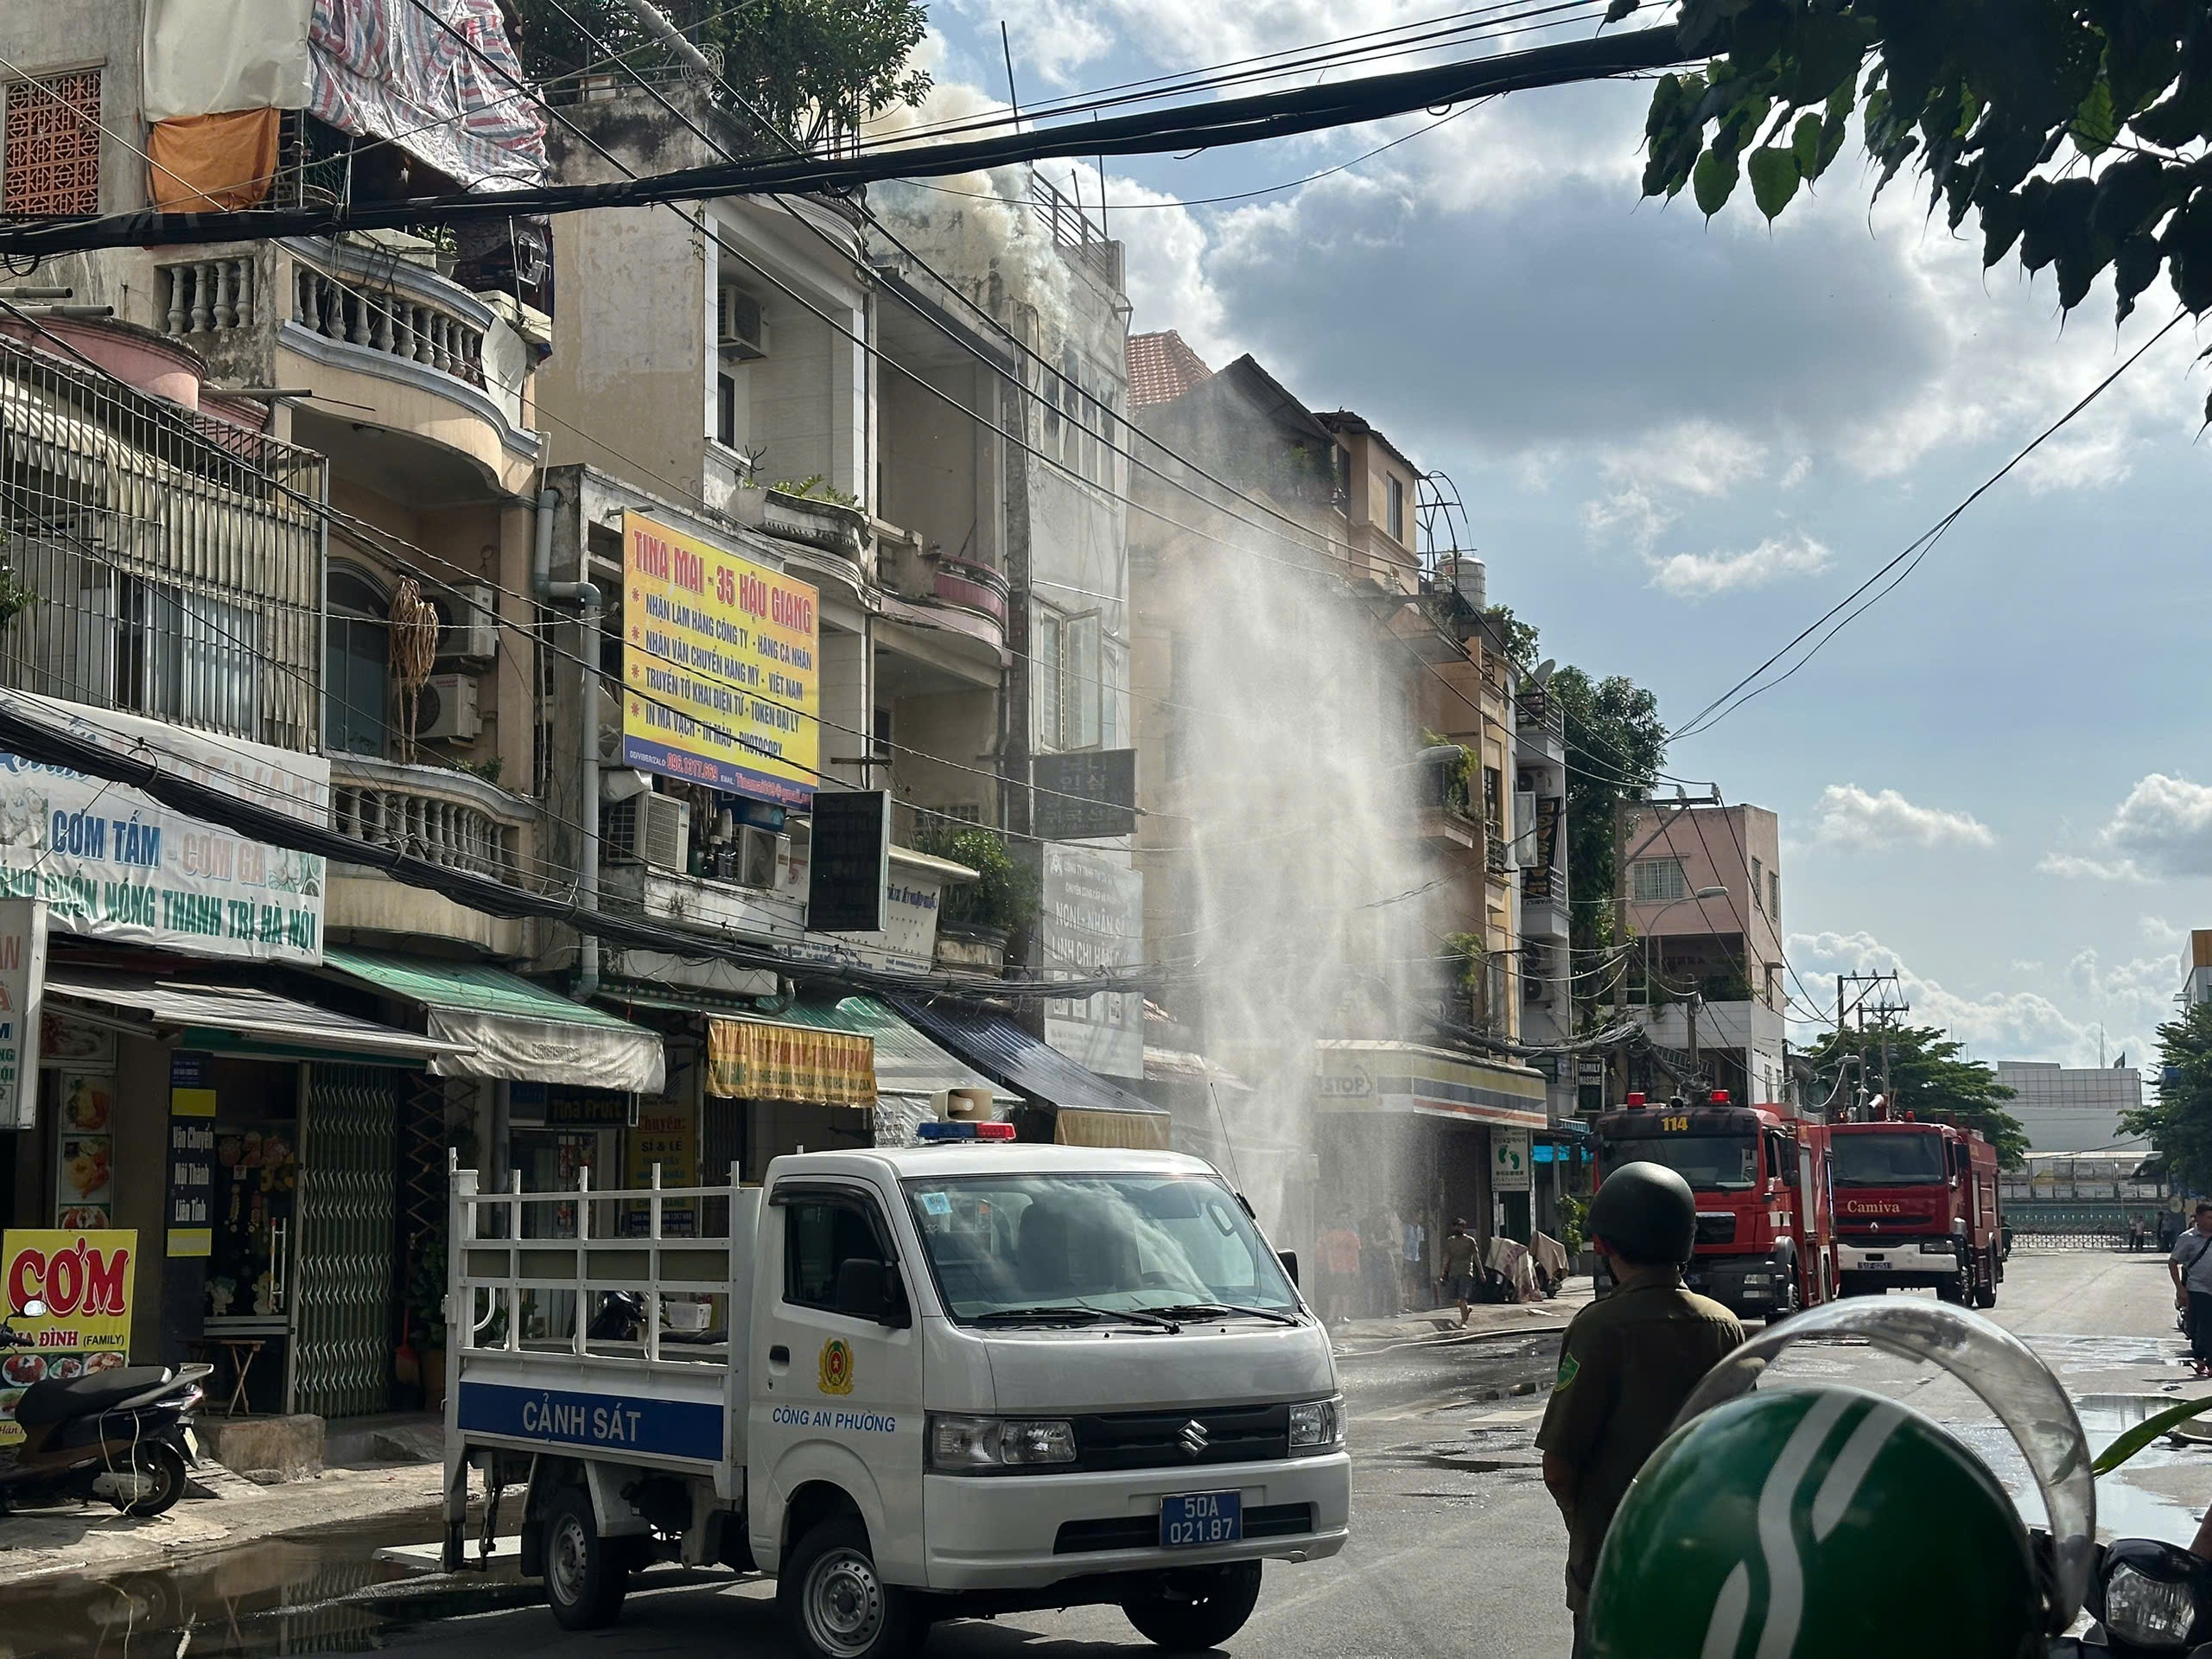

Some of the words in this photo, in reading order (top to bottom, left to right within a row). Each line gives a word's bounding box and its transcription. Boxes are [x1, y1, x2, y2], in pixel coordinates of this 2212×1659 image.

[632, 530, 670, 582] TINA
[674, 547, 704, 596] MAI
[715, 564, 735, 606] 35
[738, 570, 767, 623] HẬU
[770, 588, 812, 635] GIANG
[645, 592, 670, 624] NHẬN
[671, 599, 690, 628] LÀM
[691, 607, 714, 635] HÀNG
[715, 614, 738, 645] CÔNG
[739, 626, 748, 650] TY
[757, 629, 778, 659] HÀNG
[779, 639, 790, 665] CÁ
[791, 645, 812, 671] NHÂN
[645, 629, 669, 660] NHẬN
[724, 653, 746, 683] HÀNG
[747, 662, 760, 688] MỸ
[768, 670, 785, 698] VIỆT
[785, 678, 804, 702] NAM
[692, 684, 711, 706] KHAI
[713, 689, 732, 716] ĐIỆN
[751, 700, 774, 726] TOKEN
[776, 709, 790, 736] ĐẠI
[645, 702, 655, 727] IN
[673, 712, 696, 739] VẠCH
[702, 720, 713, 741] IN
[739, 731, 783, 761] PHOTOCOPY
[52, 809, 105, 861] CƠM
[111, 809, 162, 868] TẤM
[182, 830, 232, 882] CƠM
[104, 876, 156, 928] NÓNG
[162, 889, 223, 938] THANH
[227, 895, 255, 940] TRÌ
[261, 899, 283, 945] HÀ
[289, 904, 316, 957] NỘI
[1055, 900, 1080, 931] NONI
[1052, 935, 1074, 962] LINH
[1076, 940, 1092, 967] CHI
[531, 1043, 582, 1064] LOGISTICS
[1579, 1063, 1601, 1073] FAMILY
[1579, 1076, 1601, 1085] MASSAGE
[1661, 1116, 1688, 1131] 114
[173, 1126, 187, 1154] Vận
[175, 1198, 190, 1221] Liên
[1847, 1199, 1902, 1214] Camiva
[7, 1236, 129, 1318] CƠM
[39, 1326, 79, 1346] ĐÌNH
[83, 1334, 124, 1347] (FAMILY)
[522, 1392, 586, 1437] CẢNH
[593, 1402, 641, 1442] SÁT
[772, 1406, 807, 1427] CÔNG
[812, 1410, 831, 1427] AN
[835, 1408, 896, 1433] PHƯỜNG
[1184, 1495, 1219, 1518] 50A
[1170, 1517, 1234, 1544] 021.87
